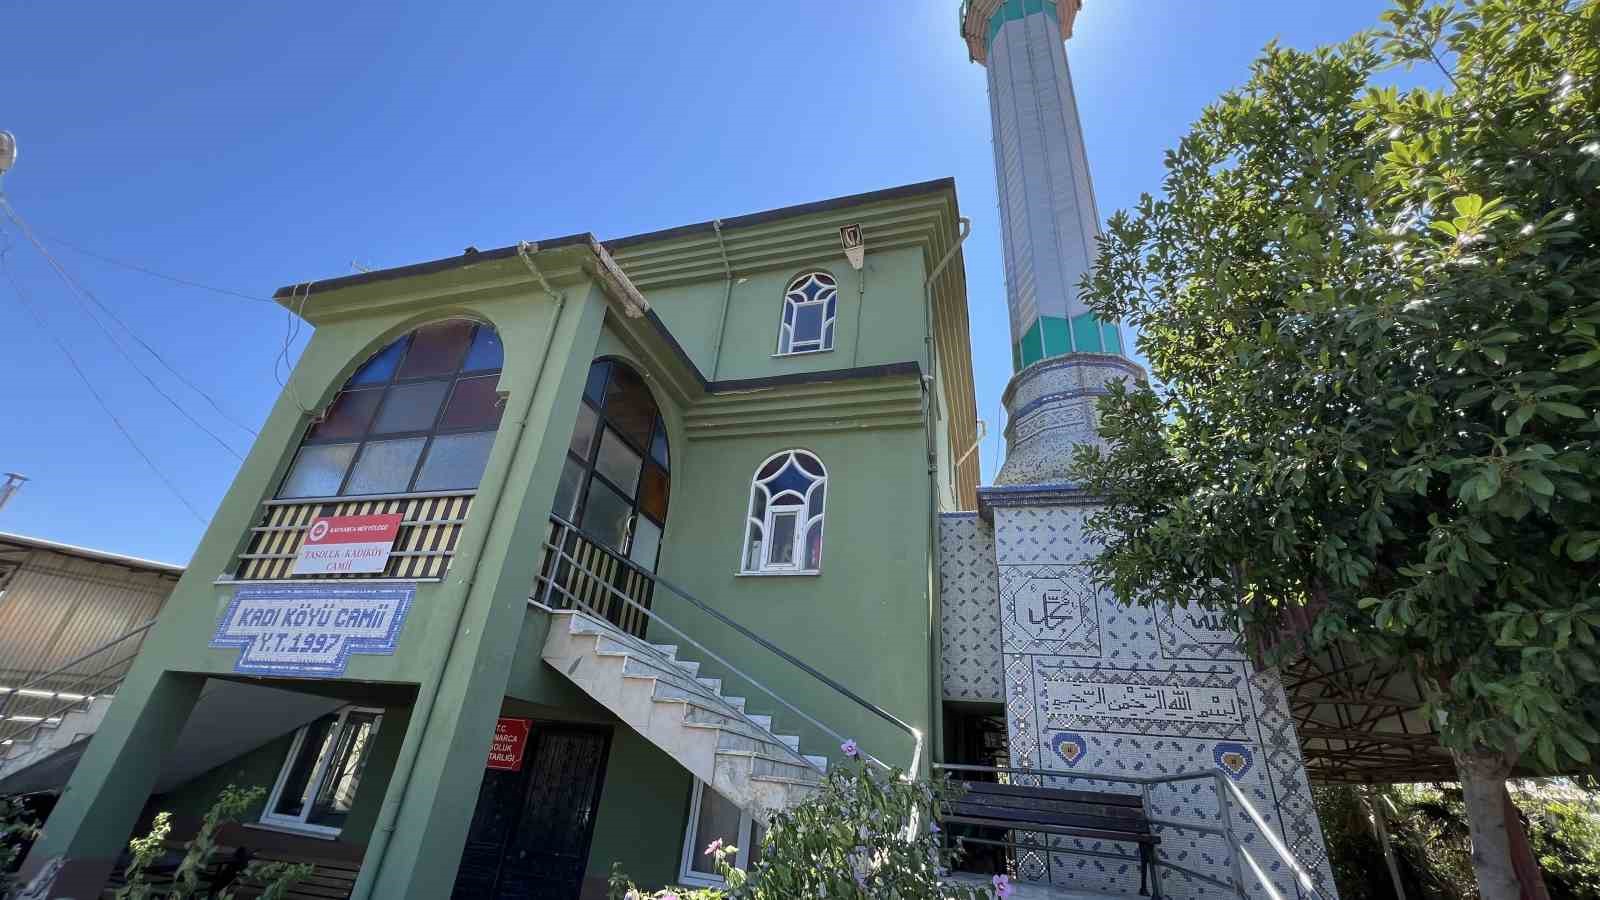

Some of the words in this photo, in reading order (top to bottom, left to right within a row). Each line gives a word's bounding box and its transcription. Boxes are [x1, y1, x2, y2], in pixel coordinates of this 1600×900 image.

[239, 607, 281, 627] KADI
[281, 603, 336, 628] KÖYÜ
[496, 734, 518, 743] NARCA
